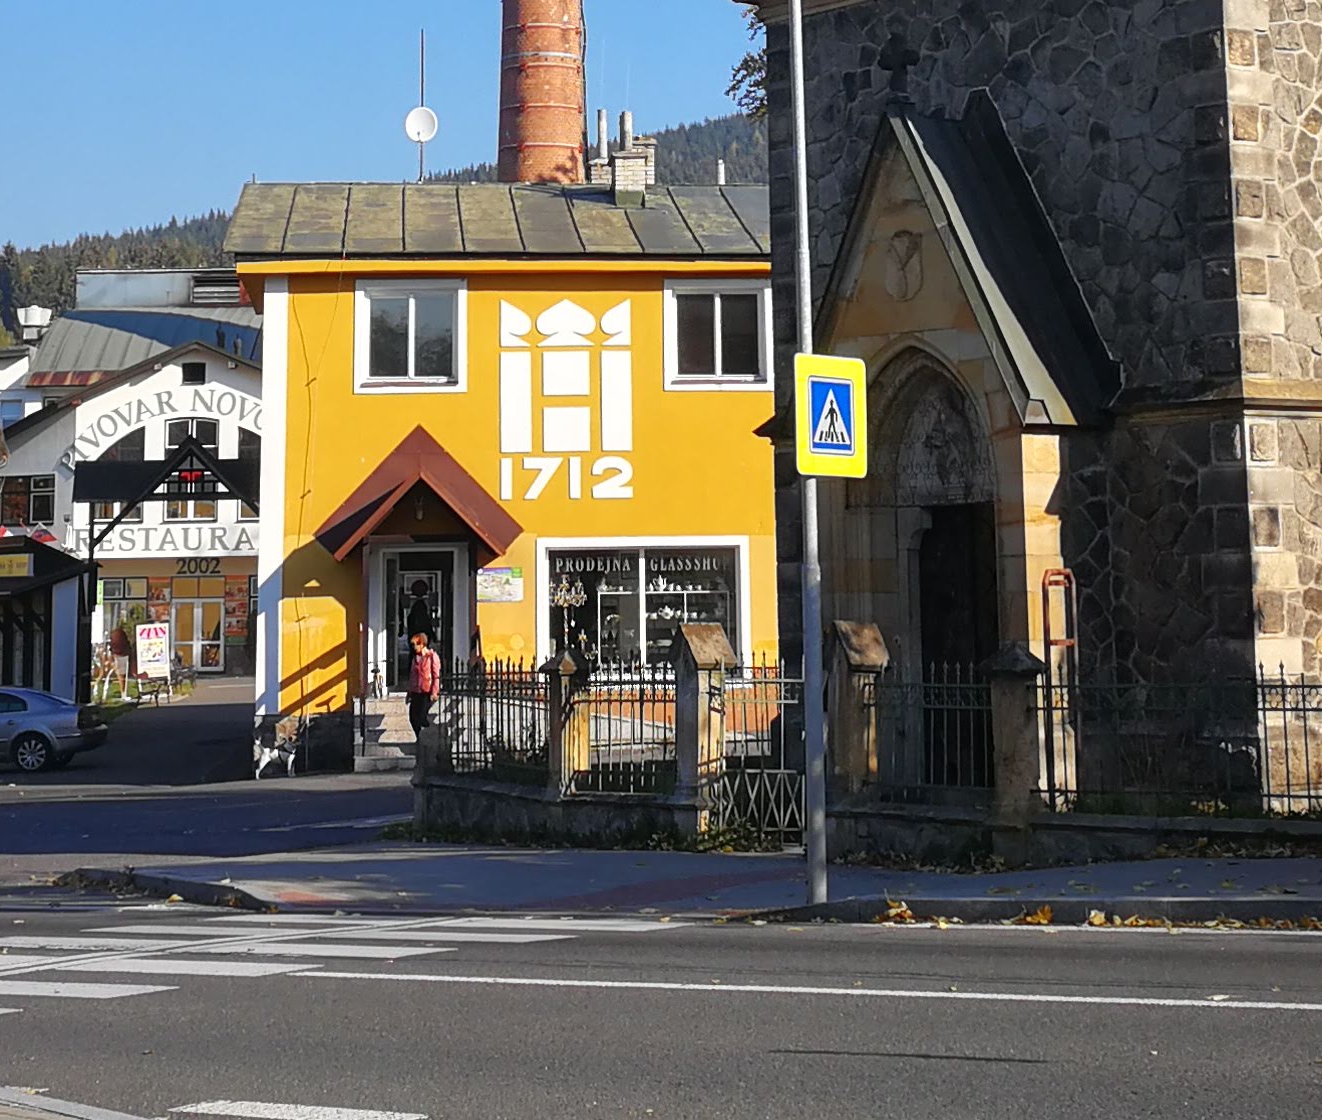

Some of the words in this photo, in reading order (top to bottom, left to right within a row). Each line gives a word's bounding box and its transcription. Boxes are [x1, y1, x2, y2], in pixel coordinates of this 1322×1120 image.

[60, 390, 178, 472] PIVOVAR
[500, 456, 634, 500] 1712
[75, 526, 260, 551] RESTAURA
[176, 558, 221, 575] 2002
[555, 556, 631, 574] PRODEJNA
[650, 555, 727, 572] GLASSSHO
